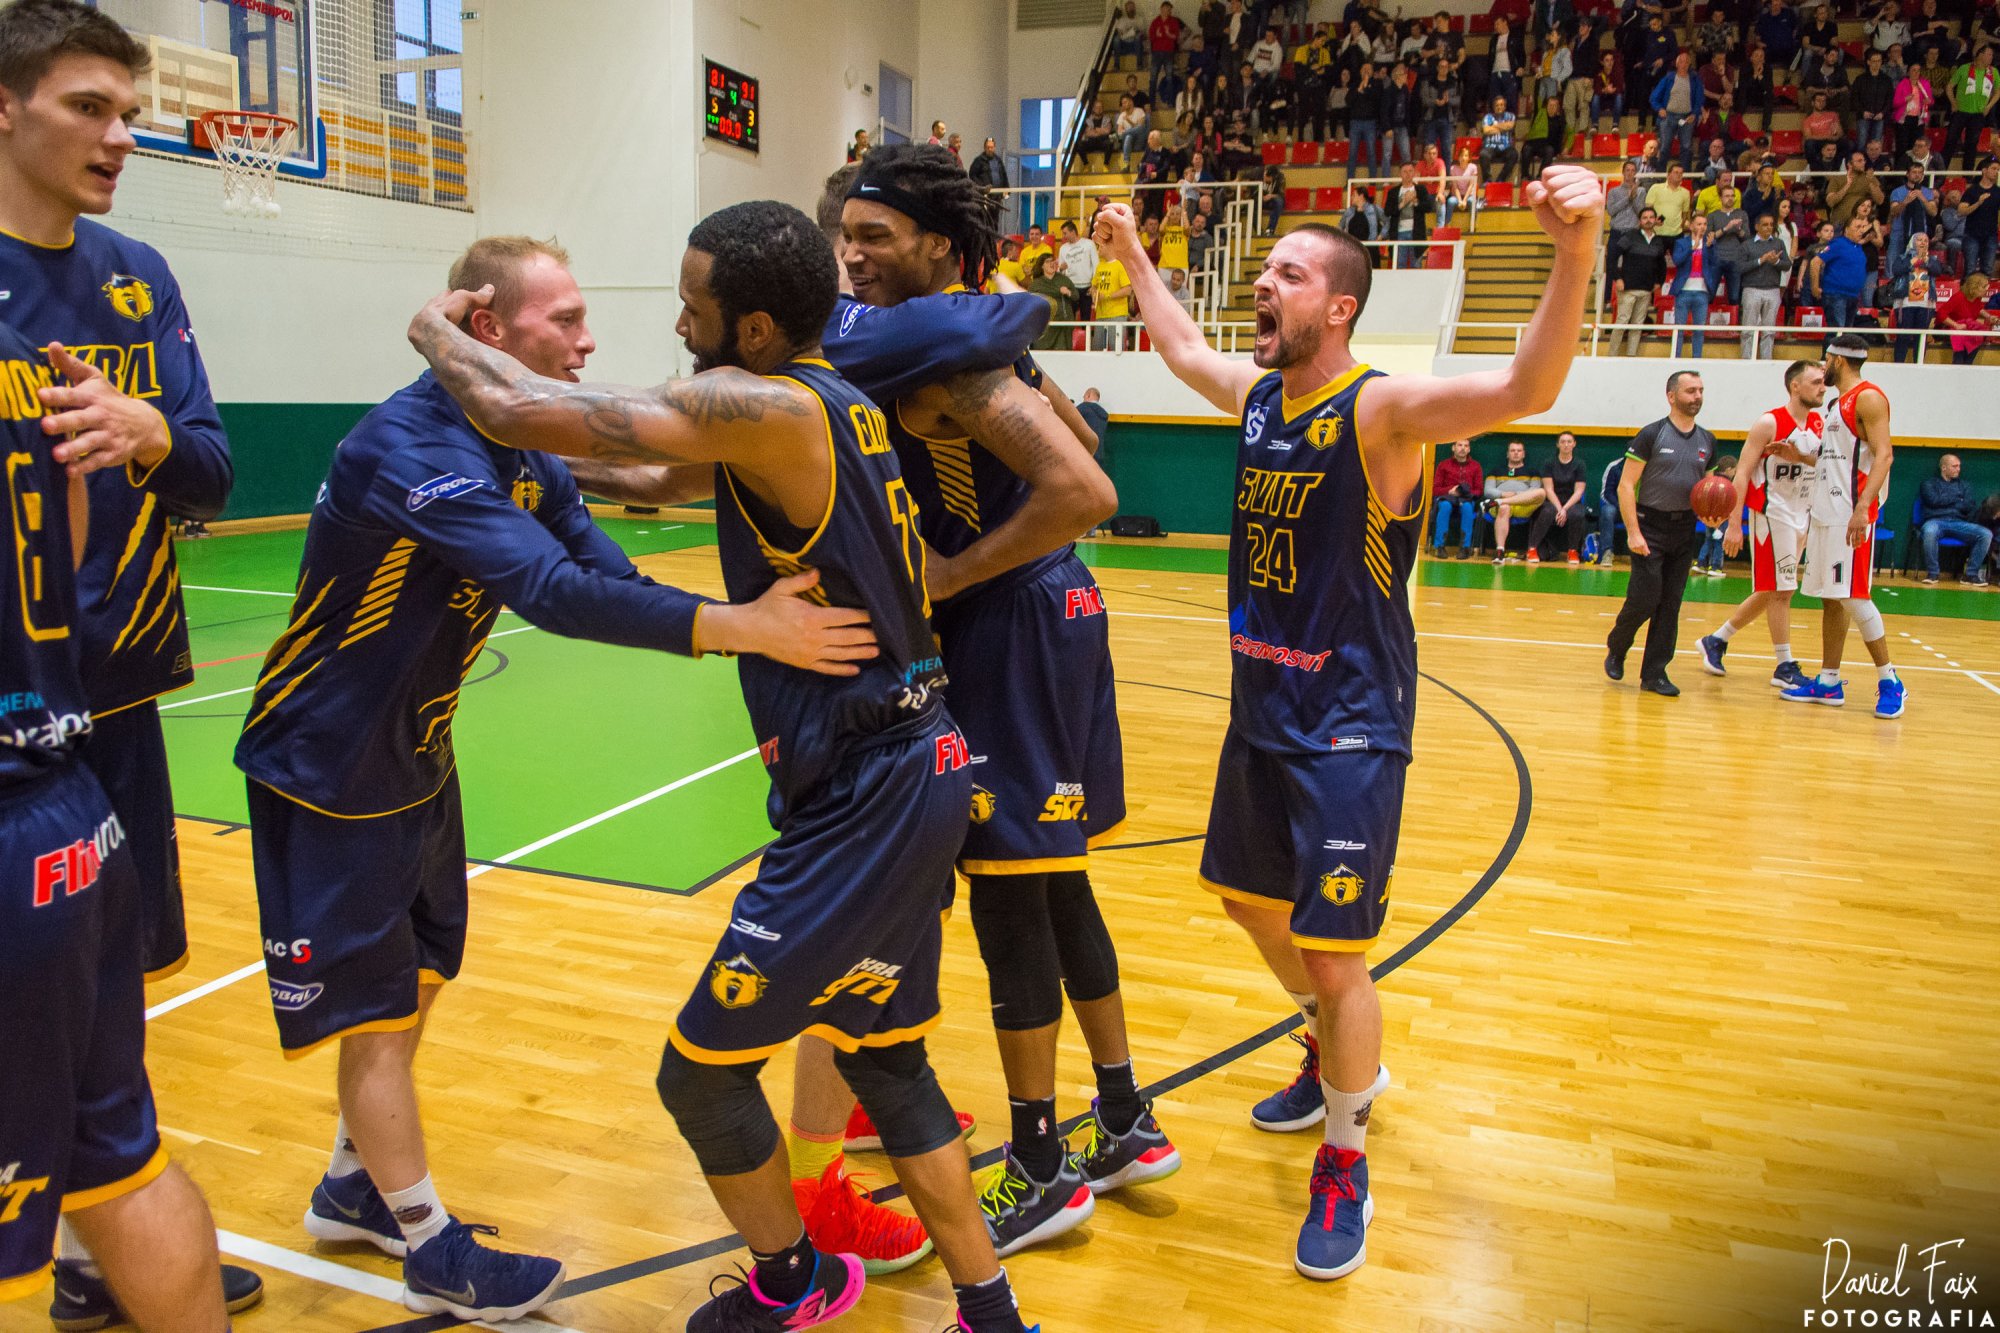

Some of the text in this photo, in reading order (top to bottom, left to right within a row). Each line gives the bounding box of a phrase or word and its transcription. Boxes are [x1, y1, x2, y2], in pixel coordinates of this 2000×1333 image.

[711, 68, 724, 89] 81
[741, 81, 755, 100] 91
[730, 90, 737, 105] 4
[748, 109, 755, 127] 3
[1776, 464, 1802, 480] PP
[1238, 467, 1326, 518] SVIT
[1247, 522, 1297, 594] 24
[1832, 561, 1844, 585] 1
[1231, 633, 1333, 672] CHEMOSVIT
